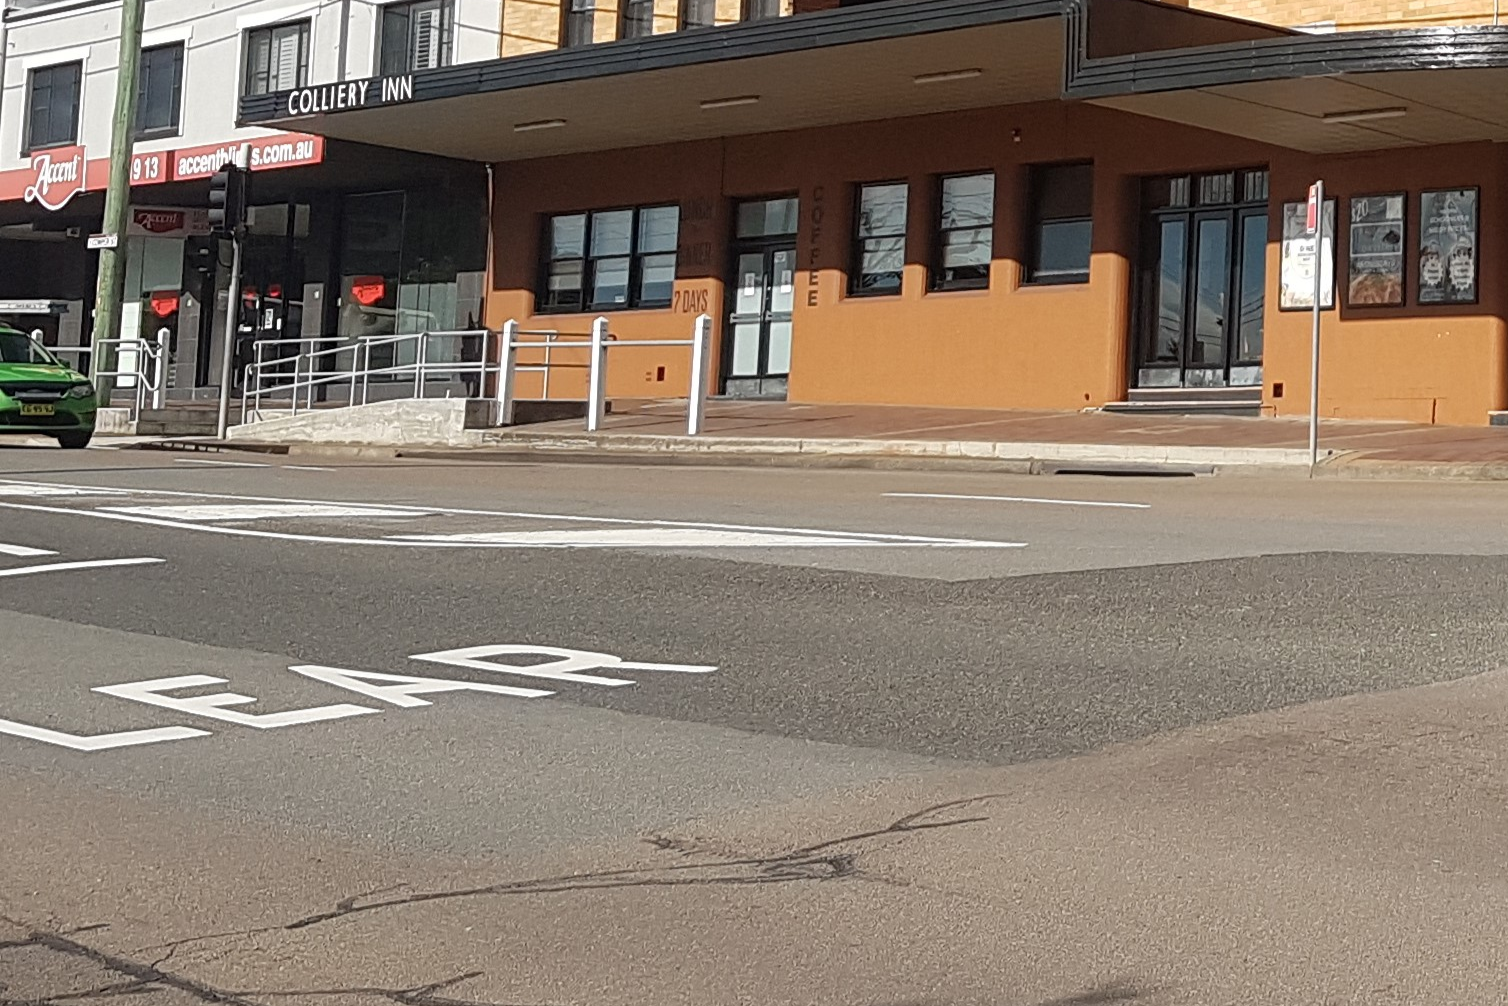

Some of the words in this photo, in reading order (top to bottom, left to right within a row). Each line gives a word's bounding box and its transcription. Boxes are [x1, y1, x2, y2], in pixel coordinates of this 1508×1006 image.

[288, 80, 369, 115] COLLIERY
[381, 74, 412, 103] INN
[28, 154, 79, 197] Accent
[133, 157, 142, 180] 9
[144, 155, 159, 179] 13
[806, 185, 825, 308] COFFEE
[682, 288, 709, 314] DAYS
